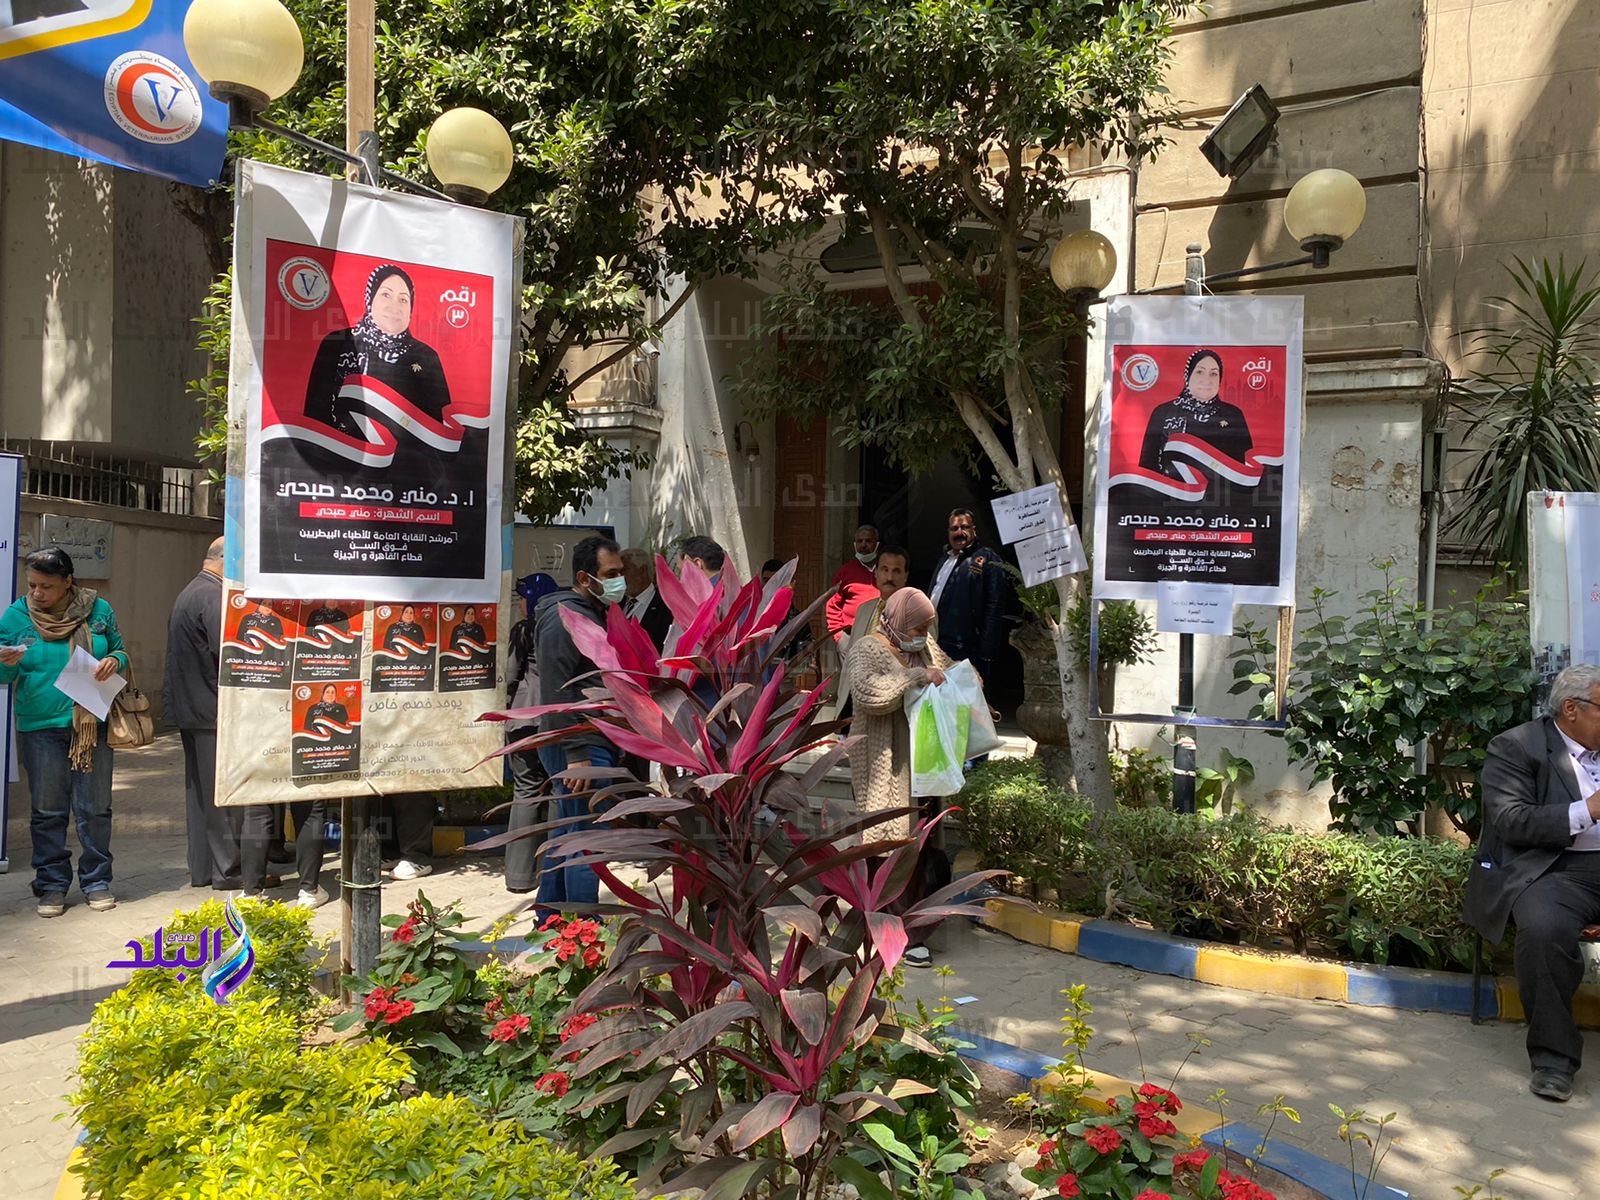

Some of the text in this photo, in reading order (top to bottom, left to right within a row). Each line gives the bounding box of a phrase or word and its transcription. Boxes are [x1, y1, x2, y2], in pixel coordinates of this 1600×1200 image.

[143, 78, 183, 122] V
[108, 92, 199, 142] EGYPTIAN VETERINARIANS SYNDICATE
[298, 272, 319, 297] V
[439, 286, 476, 307] رقم
[451, 309, 465, 321] ٣
[1242, 357, 1272, 372] رقم
[1136, 365, 1150, 381] V
[1252, 375, 1263, 386] ٣
[276, 481, 335, 500] صبحي
[341, 485, 394, 502] محمد
[443, 491, 458, 505] د.
[373, 509, 414, 521] الشهرة:
[415, 512, 440, 522] اسم
[1117, 514, 1160, 528] صبحي
[1163, 515, 1205, 527] محمد
[1244, 516, 1257, 528] د.
[299, 528, 341, 539] البيطريين
[373, 530, 400, 541] العامة
[402, 532, 427, 543] النقابة
[428, 533, 453, 544] مرشد
[1221, 534, 1242, 542] اسم
[333, 550, 423, 562] قطاع القاهرة و الجيزة
[1231, 550, 1252, 559] مرشد
[368, 698, 463, 713] يوجد خصم خاص
